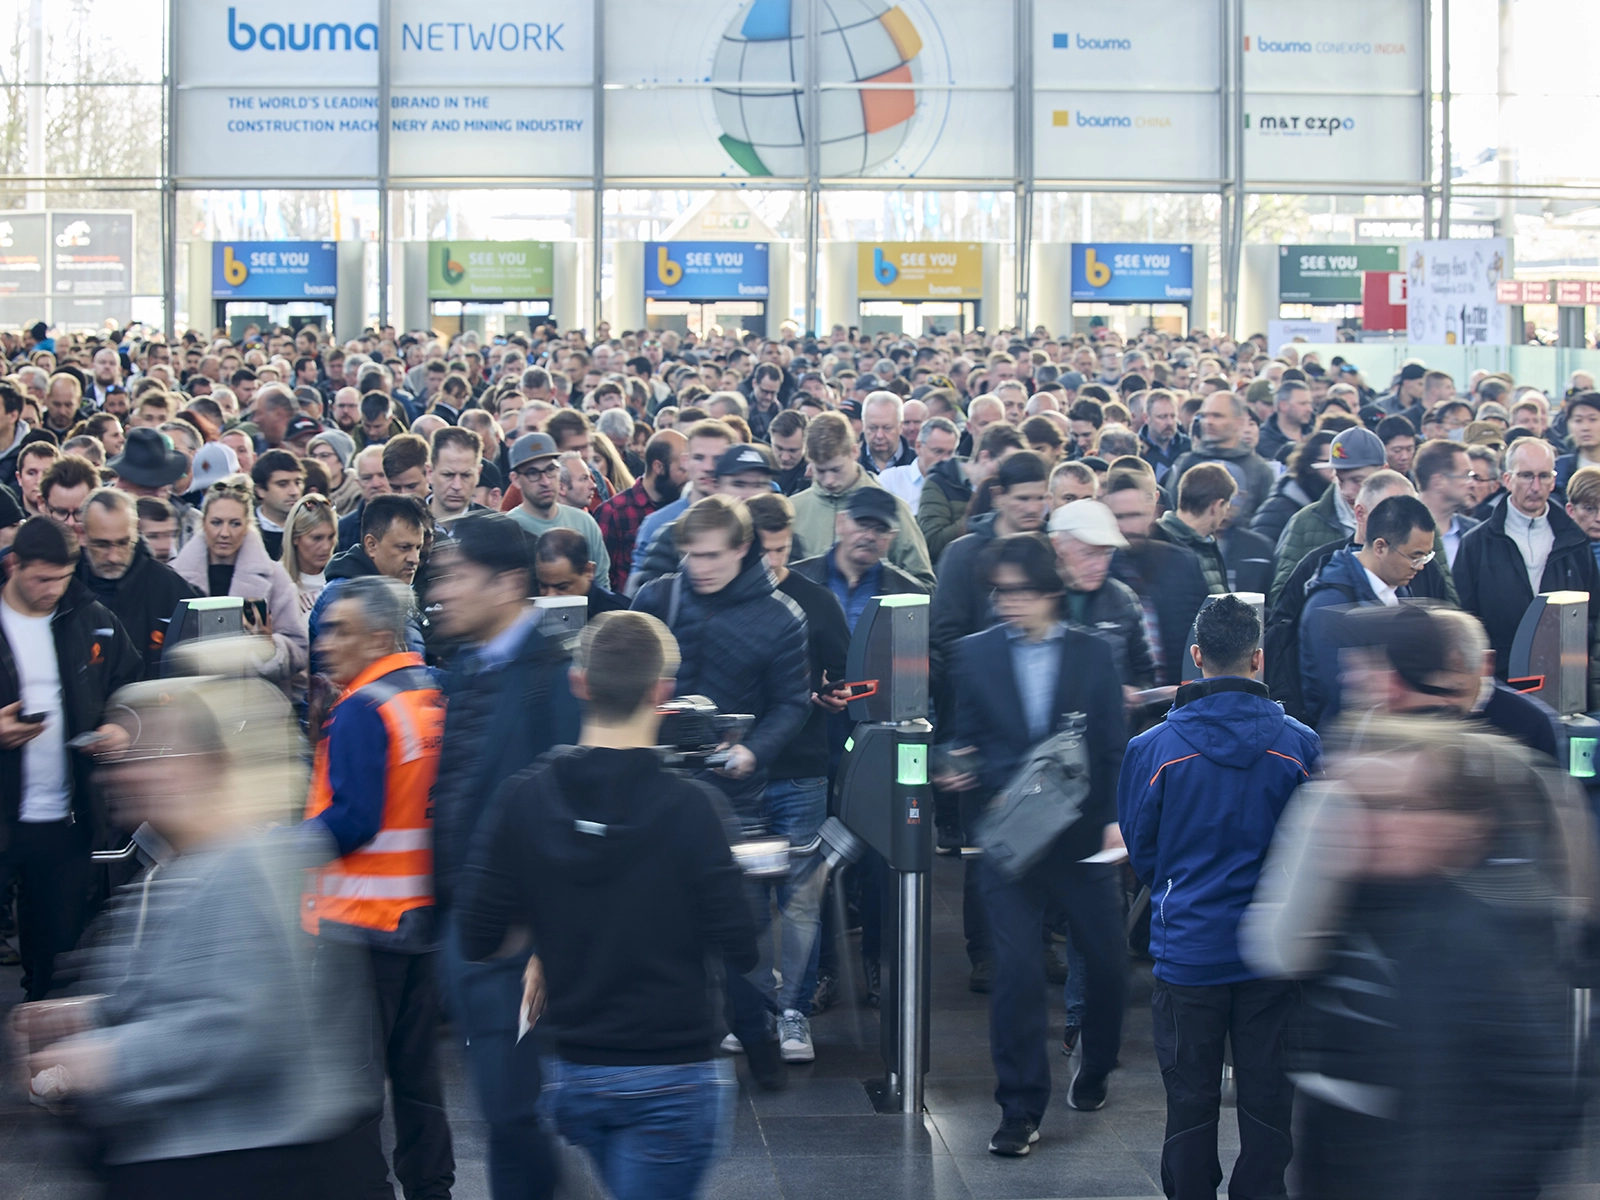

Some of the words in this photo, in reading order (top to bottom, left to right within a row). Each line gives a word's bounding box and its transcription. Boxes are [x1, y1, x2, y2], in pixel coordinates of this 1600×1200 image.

[227, 6, 379, 51] bauma
[402, 22, 565, 52] NETWORK
[1075, 33, 1132, 51] bauma
[1257, 36, 1312, 53] bauma
[1315, 41, 1372, 54] CONEXPO
[1374, 43, 1407, 55] INDIA
[228, 96, 255, 110] THE
[258, 96, 320, 110] WORLD'S
[391, 96, 441, 109] BRAND
[444, 96, 459, 109] IN
[463, 96, 489, 109] THE
[227, 119, 335, 132] CONSTRUCTION
[339, 119, 427, 132] MACHNERY
[431, 119, 461, 132] AND
[464, 119, 513, 132] MINING
[515, 119, 584, 132] INDUSTRY
[1075, 111, 1132, 128] bauma
[1135, 117, 1172, 129] CHINA
[250, 252, 277, 267] SEE
[279, 252, 310, 267] YOU
[468, 252, 495, 266] SEE
[498, 252, 527, 266] YOU
[685, 252, 713, 267] SEE
[715, 252, 744, 267] YOU
[900, 253, 927, 267] SEE
[929, 253, 958, 267] YOU
[1113, 254, 1141, 269] SEE
[1143, 254, 1171, 269] YOU
[1300, 256, 1327, 270] SEE
[1328, 256, 1358, 270] YOU
[907, 817, 921, 825] EXIT
